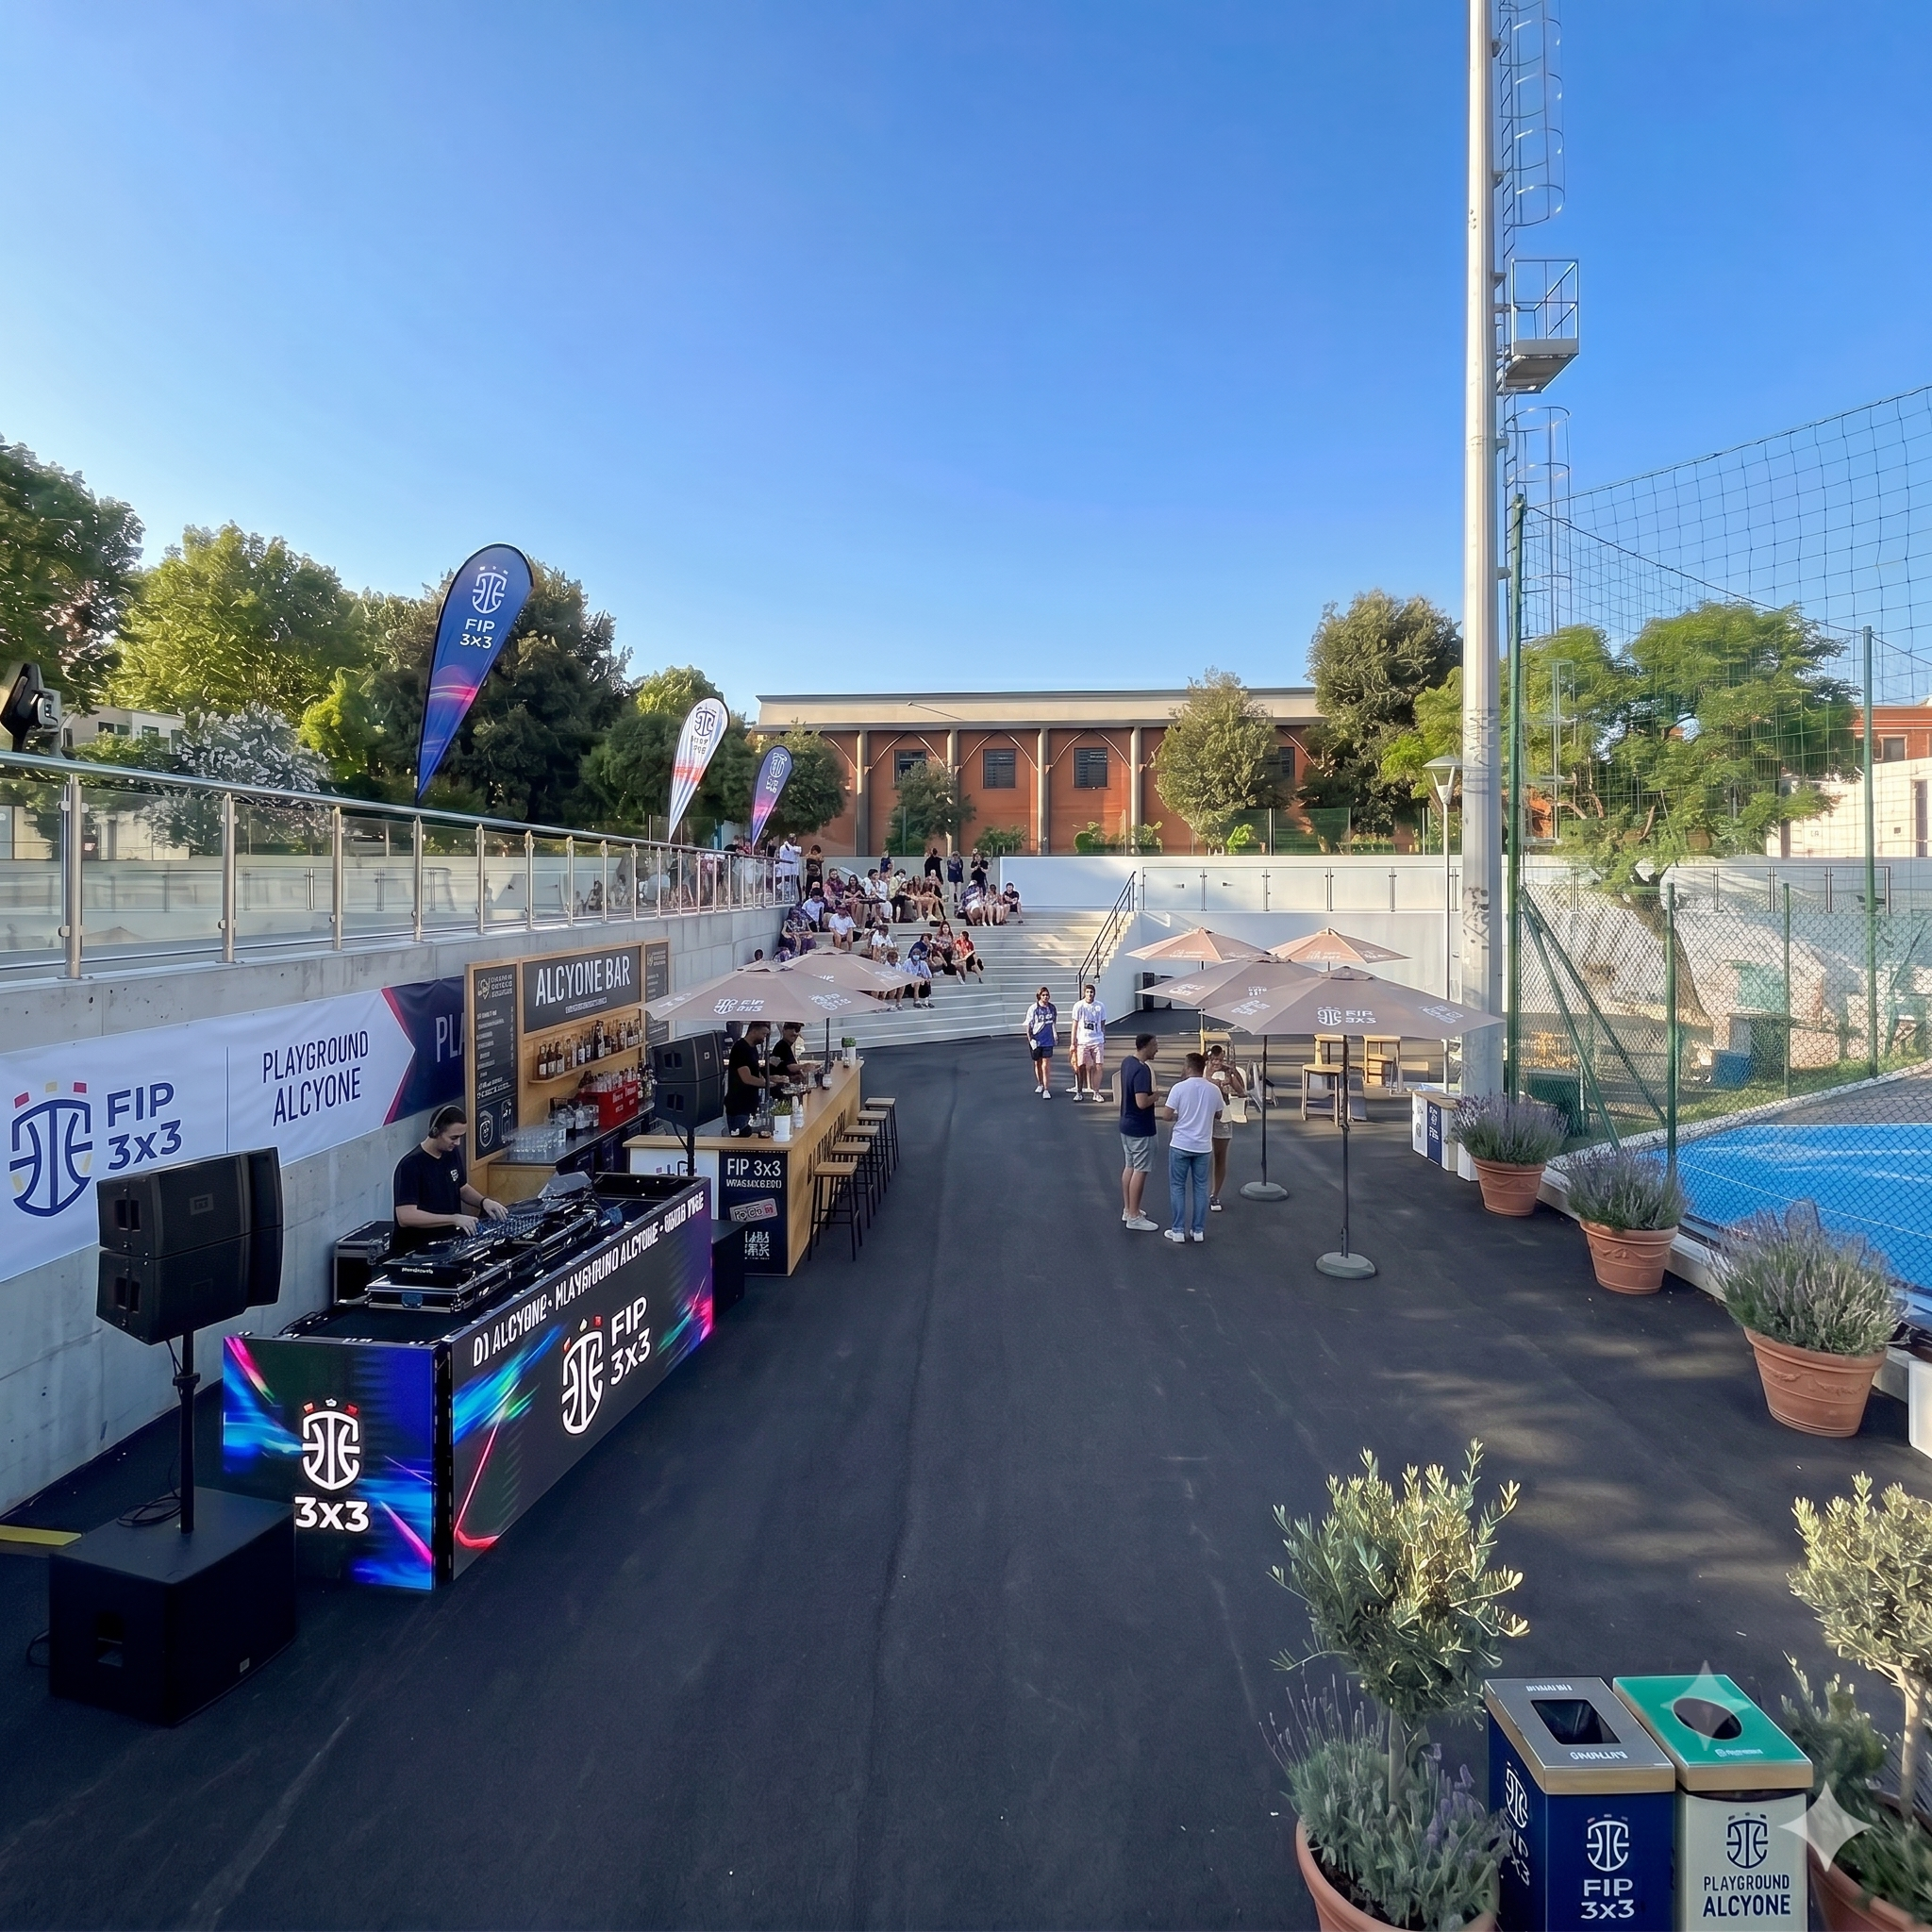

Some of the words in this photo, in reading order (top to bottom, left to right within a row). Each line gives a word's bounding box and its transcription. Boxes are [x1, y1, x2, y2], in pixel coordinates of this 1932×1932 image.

[464, 618, 495, 633] FIP
[535, 959, 603, 1007] ALCYONE
[606, 955, 631, 990] BAR
[262, 1030, 369, 1084] PLAYGROUND
[107, 1082, 175, 1128] FIP
[273, 1066, 361, 1127] ALCYONE
[108, 1119, 182, 1170] 3x3
[727, 1158, 750, 1175] FIP
[753, 1159, 781, 1176] 3x3
[611, 1296, 647, 1347] FIP
[610, 1327, 651, 1386] 3x3
[294, 1496, 370, 1532] 3x3
[1583, 1878, 1634, 1897] FIP
[1704, 1874, 1790, 1891] PLAYGROUND
[1580, 1899, 1635, 1920] 3x3
[1703, 1894, 1791, 1918] ALCYONE
